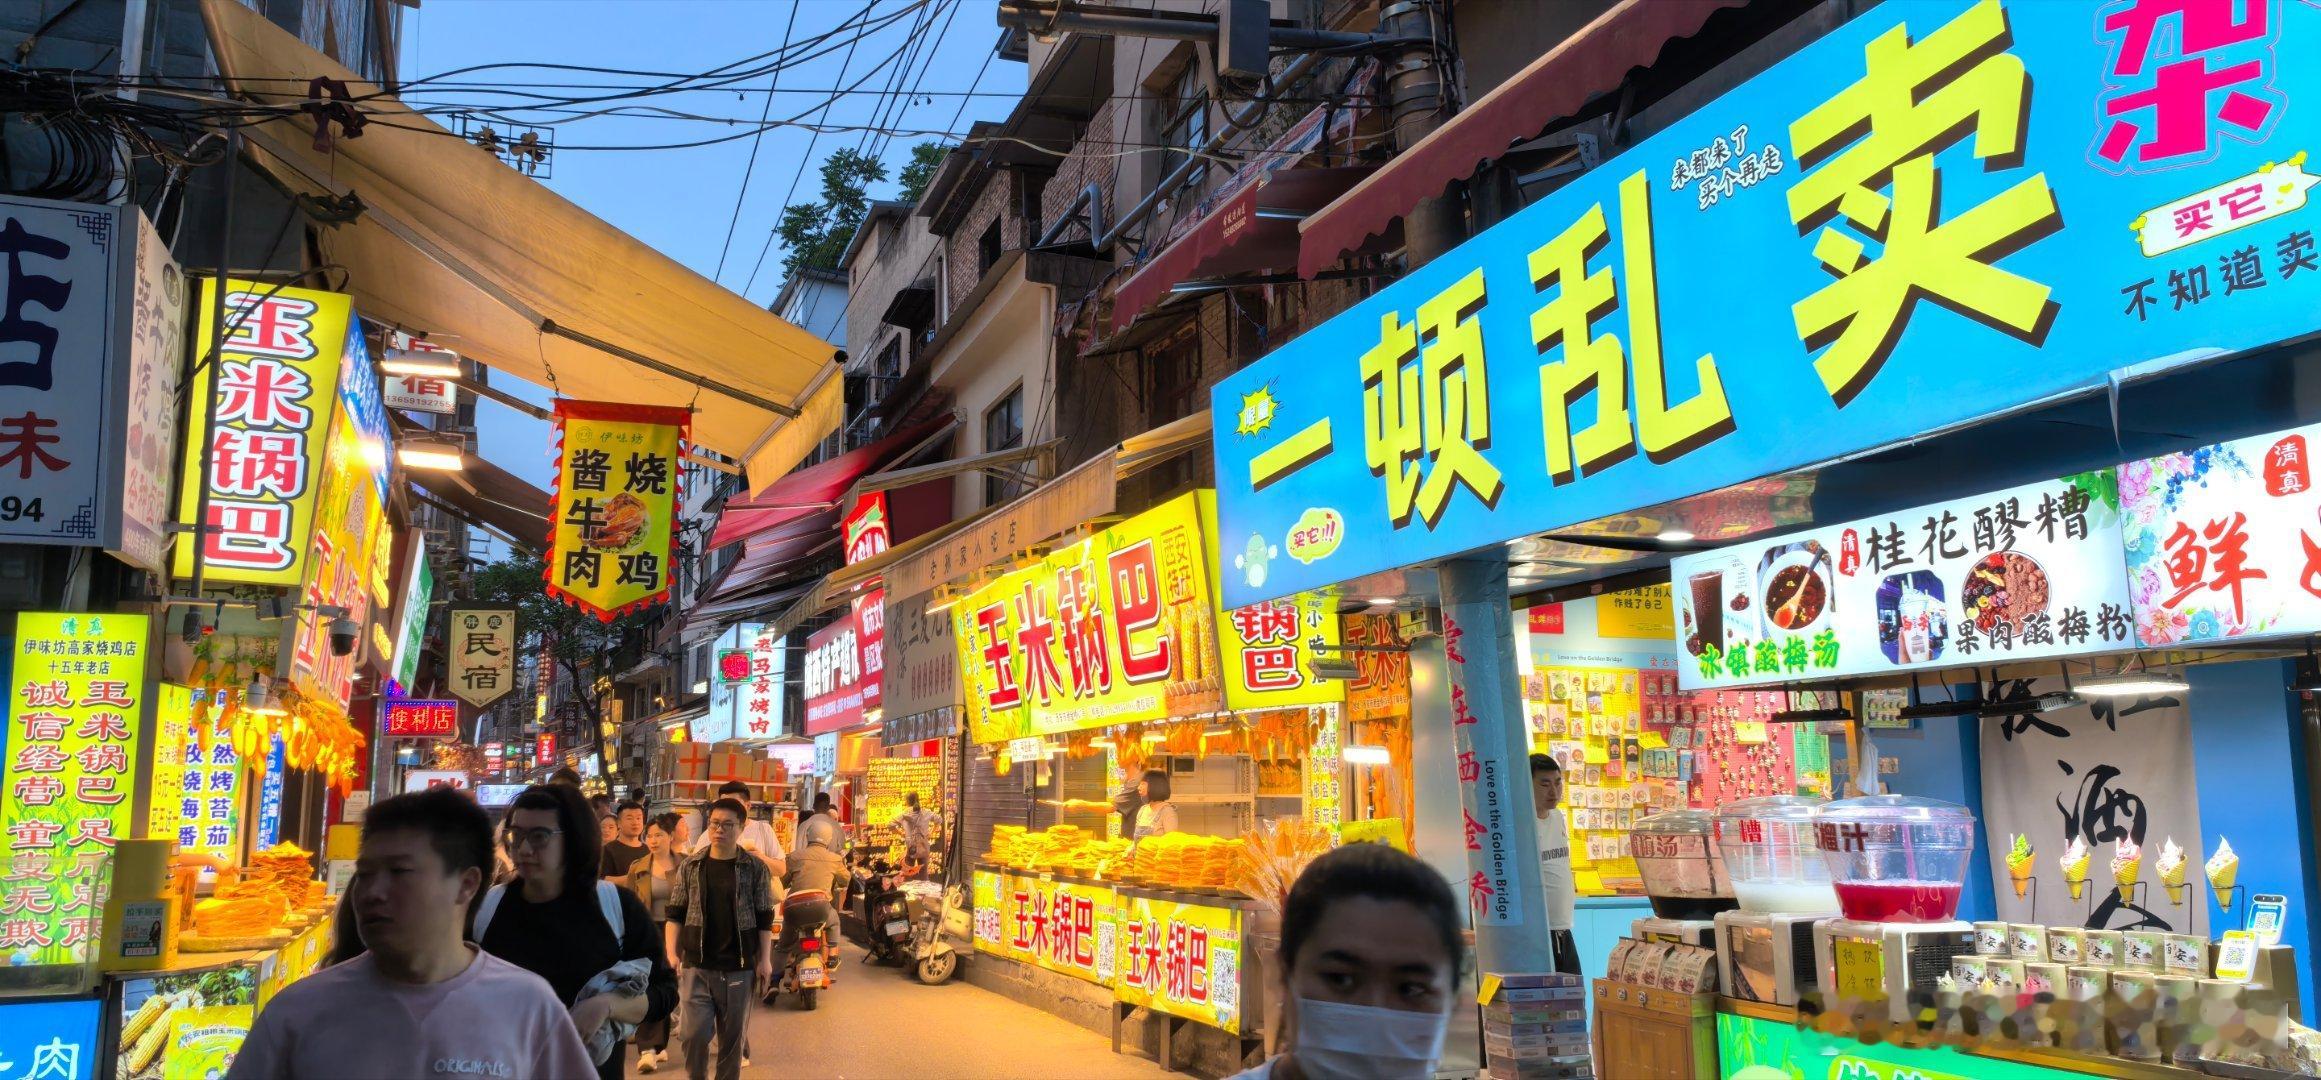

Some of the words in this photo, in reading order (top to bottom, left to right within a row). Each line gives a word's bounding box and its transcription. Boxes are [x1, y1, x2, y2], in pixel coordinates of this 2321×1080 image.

[2098, 0, 2273, 163] 杂
[1673, 126, 1747, 189] 来都来了
[1700, 146, 1783, 210] 买个再走
[2173, 183, 2266, 238] 买它
[1250, 0, 2060, 528] 一顿乱卖
[2121, 230, 2319, 322] 不知道卖
[206, 291, 320, 570] 玉米锅巴
[600, 431, 644, 444] 伊味坊
[2273, 442, 2302, 493] 清真
[563, 449, 612, 589] 酱牛肉
[616, 452, 668, 591] 烧鸡
[1866, 486, 2091, 575] 桂花醪糟
[1842, 534, 1859, 573] 清真
[24, 640, 137, 656] 伊味坊高家烧鸡店
[977, 539, 1171, 710] 玉米锅巴
[1231, 600, 1305, 691] 锅巴
[1954, 602, 2133, 657] 果肉酸梅粉
[48, 660, 110, 675] 十五年老店
[461, 633, 501, 690] 民宿
[1699, 629, 1841, 678] 冰镇酸梅汤
[748, 637, 773, 734] 老马家烤肉
[13, 680, 73, 805] 诚信经营
[76, 681, 134, 804] 玉米锅巴
[390, 706, 452, 731] 便利店
[182, 770, 234, 792] 烧烤
[1486, 760, 1496, 788] Love
[1487, 790, 1498, 805] on
[180, 797, 230, 820] 海苔
[1490, 806, 1499, 824] the
[178, 826, 229, 848] 番茄
[1492, 827, 1504, 876] Golden
[0, 819, 63, 947] 童叟无欺
[1496, 879, 1507, 920] Bridge
[974, 908, 1001, 943] 玉米锅巴
[1013, 891, 1095, 968] 玉米锅巴
[1126, 921, 1209, 1005] 玉米锅巴
[0, 1038, 77, 1080] 肉
